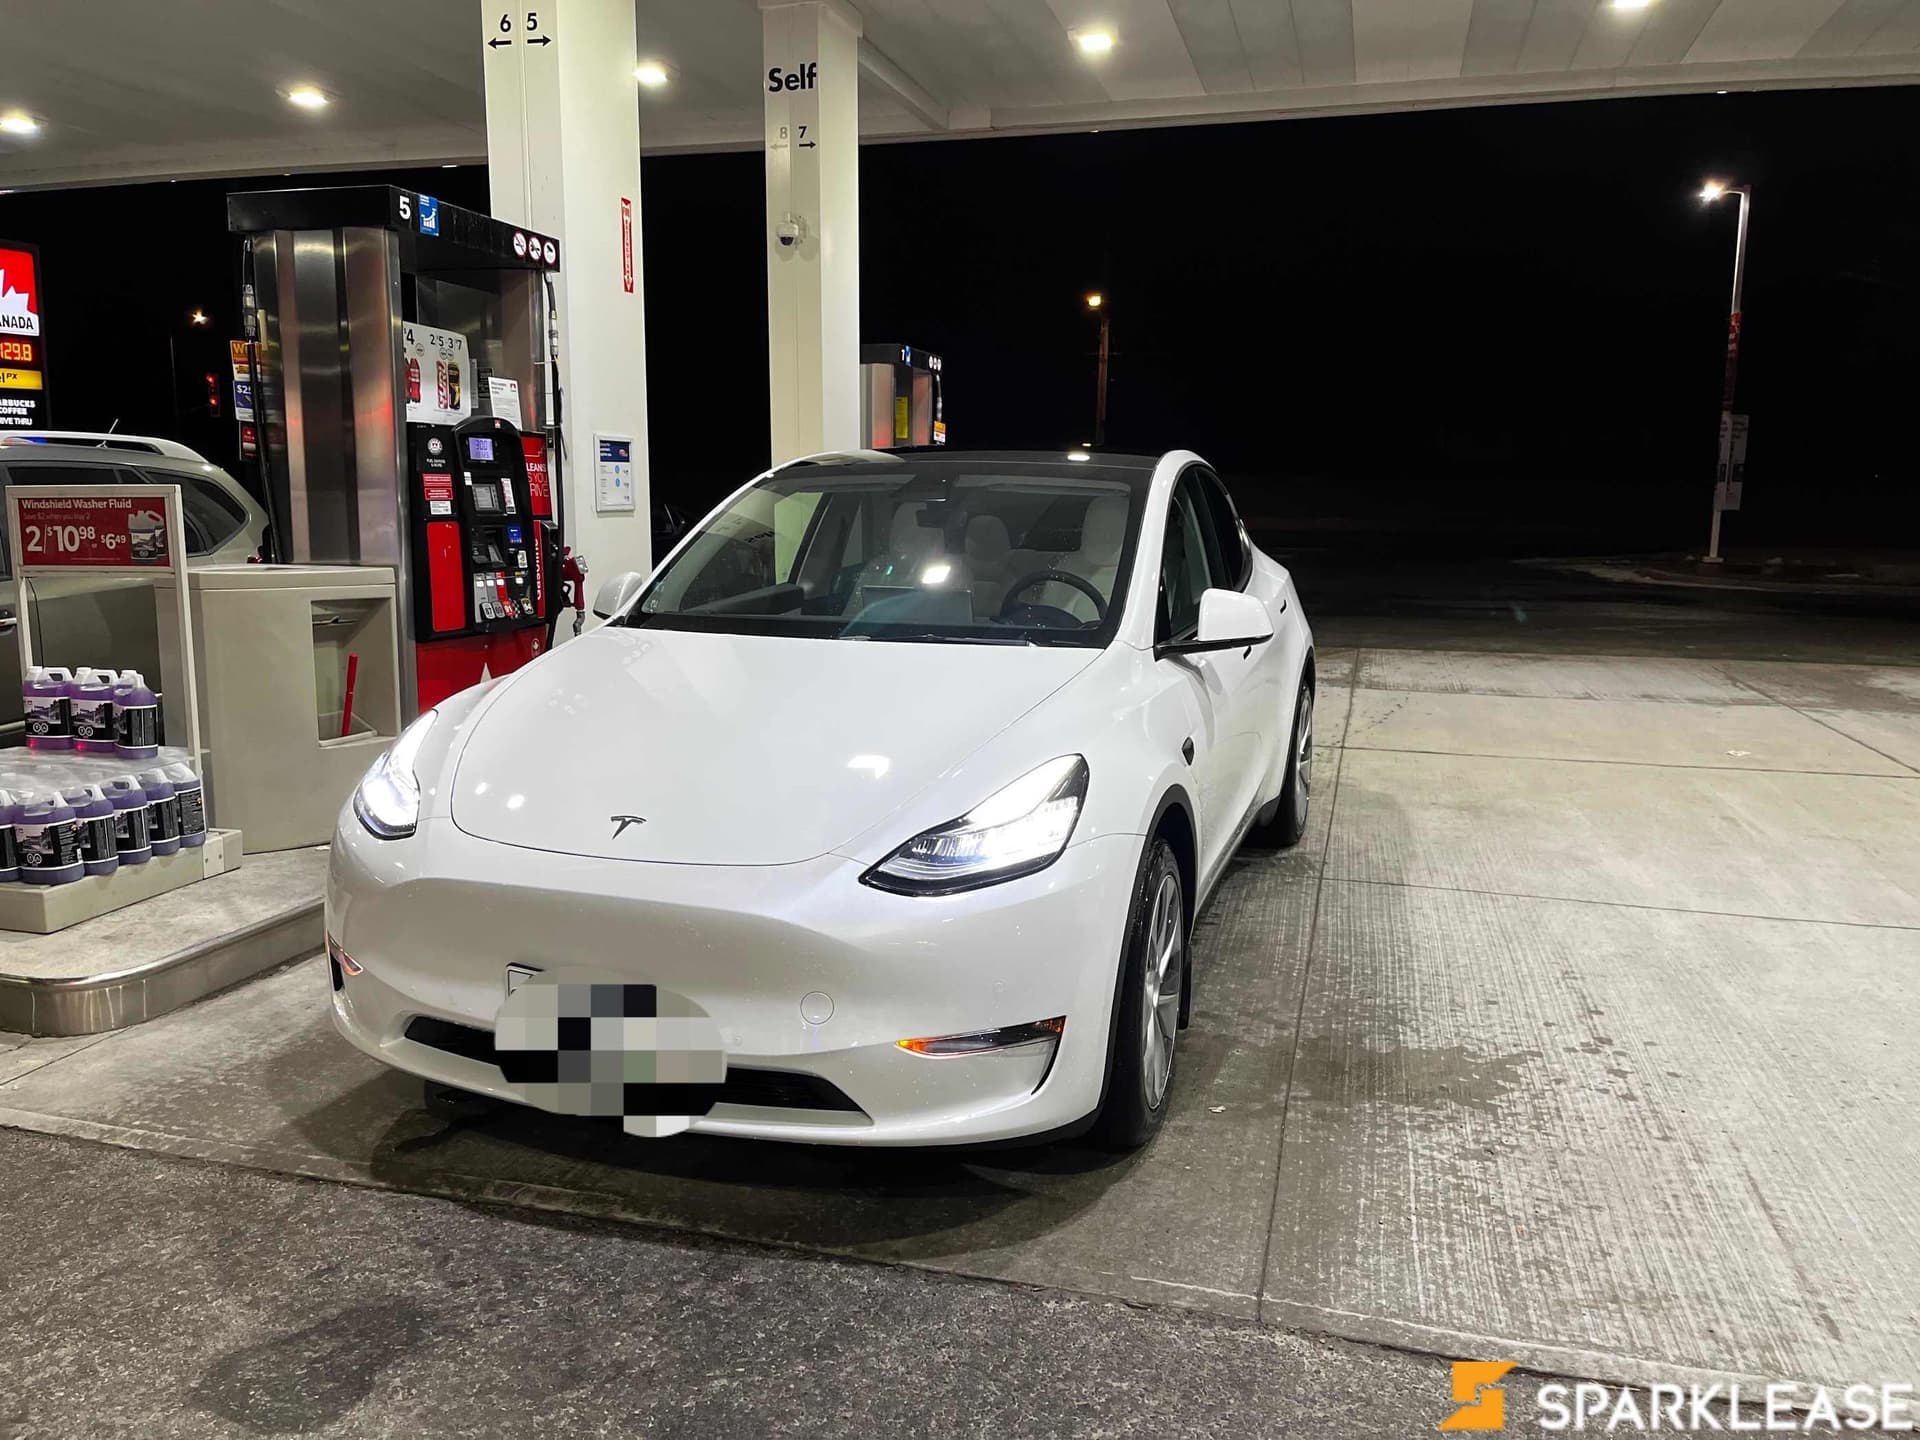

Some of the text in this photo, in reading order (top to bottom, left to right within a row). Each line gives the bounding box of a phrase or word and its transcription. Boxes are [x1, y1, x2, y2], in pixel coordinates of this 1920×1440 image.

[500, 14, 511, 32] 6
[527, 12, 538, 30] 5
[768, 62, 816, 92] Self
[780, 127, 788, 140] 8
[798, 126, 807, 138] 7
[400, 195, 411, 220] 5
[0, 314, 34, 330] NADA
[0, 398, 36, 408] RBUCKS
[22, 499, 132, 509] Windshield Washer Fluid
